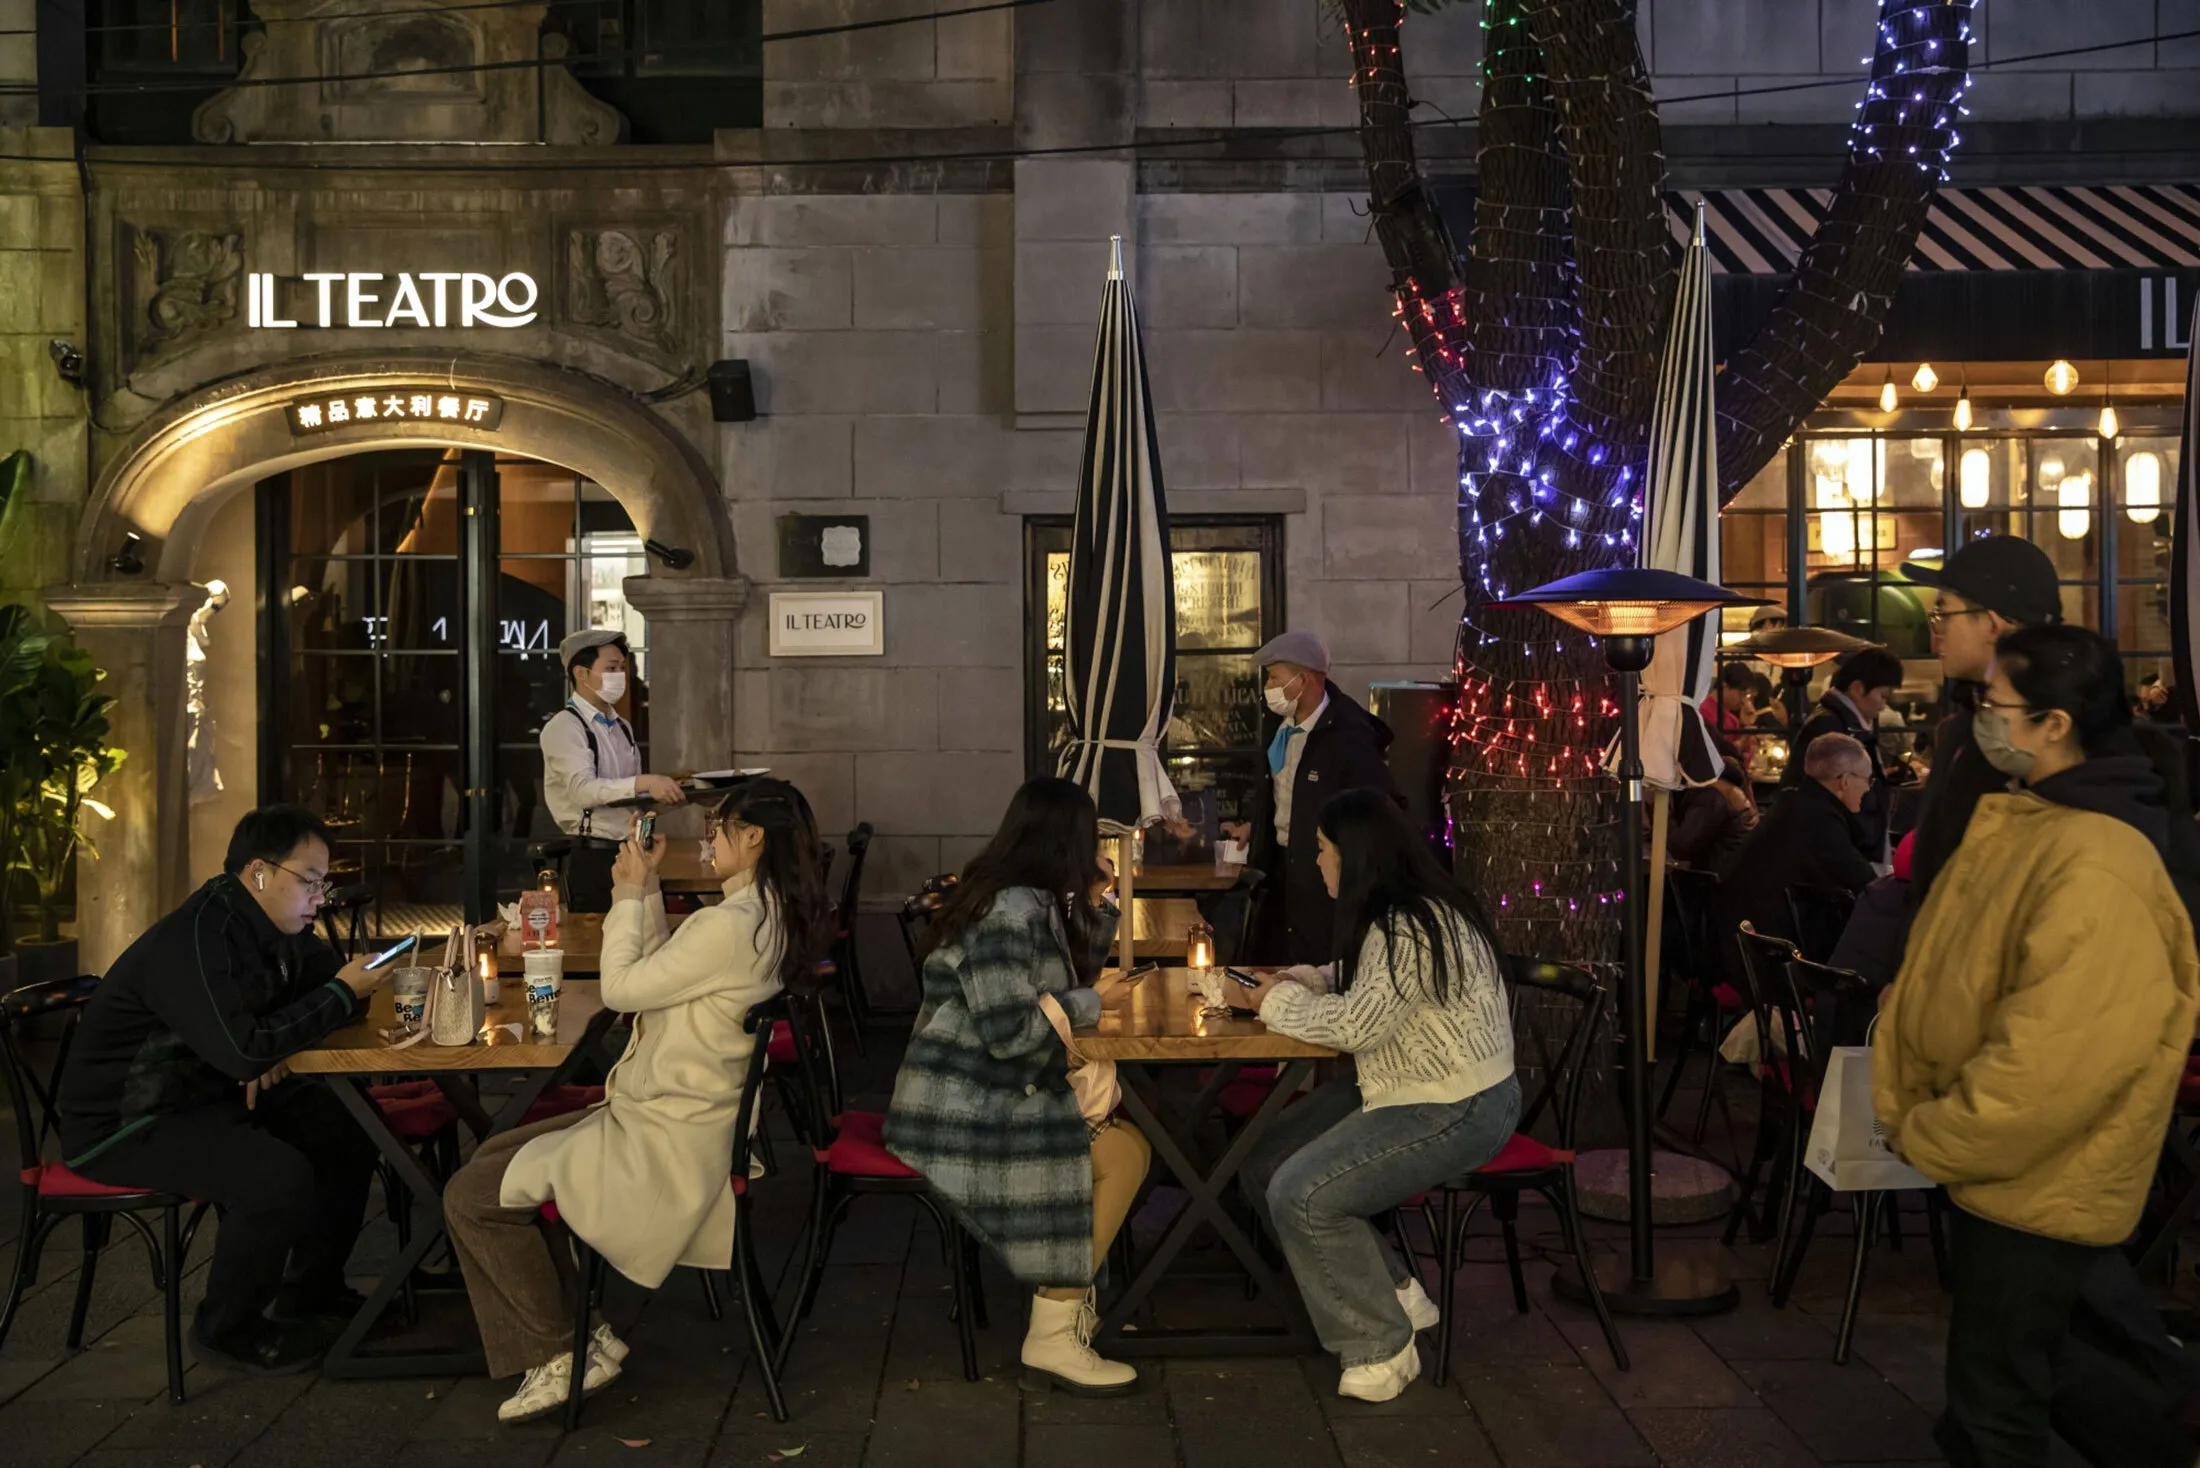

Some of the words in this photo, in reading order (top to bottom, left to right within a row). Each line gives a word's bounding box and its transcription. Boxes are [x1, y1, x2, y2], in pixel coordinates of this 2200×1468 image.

[249, 273, 297, 327] IL
[303, 272, 538, 328] TEATRO
[2140, 276, 2190, 350] IL
[298, 394, 490, 428] 精品意大利餐厅
[786, 614, 801, 630] IL
[802, 613, 867, 630] TEATRO
[395, 1002, 411, 1013] Be
